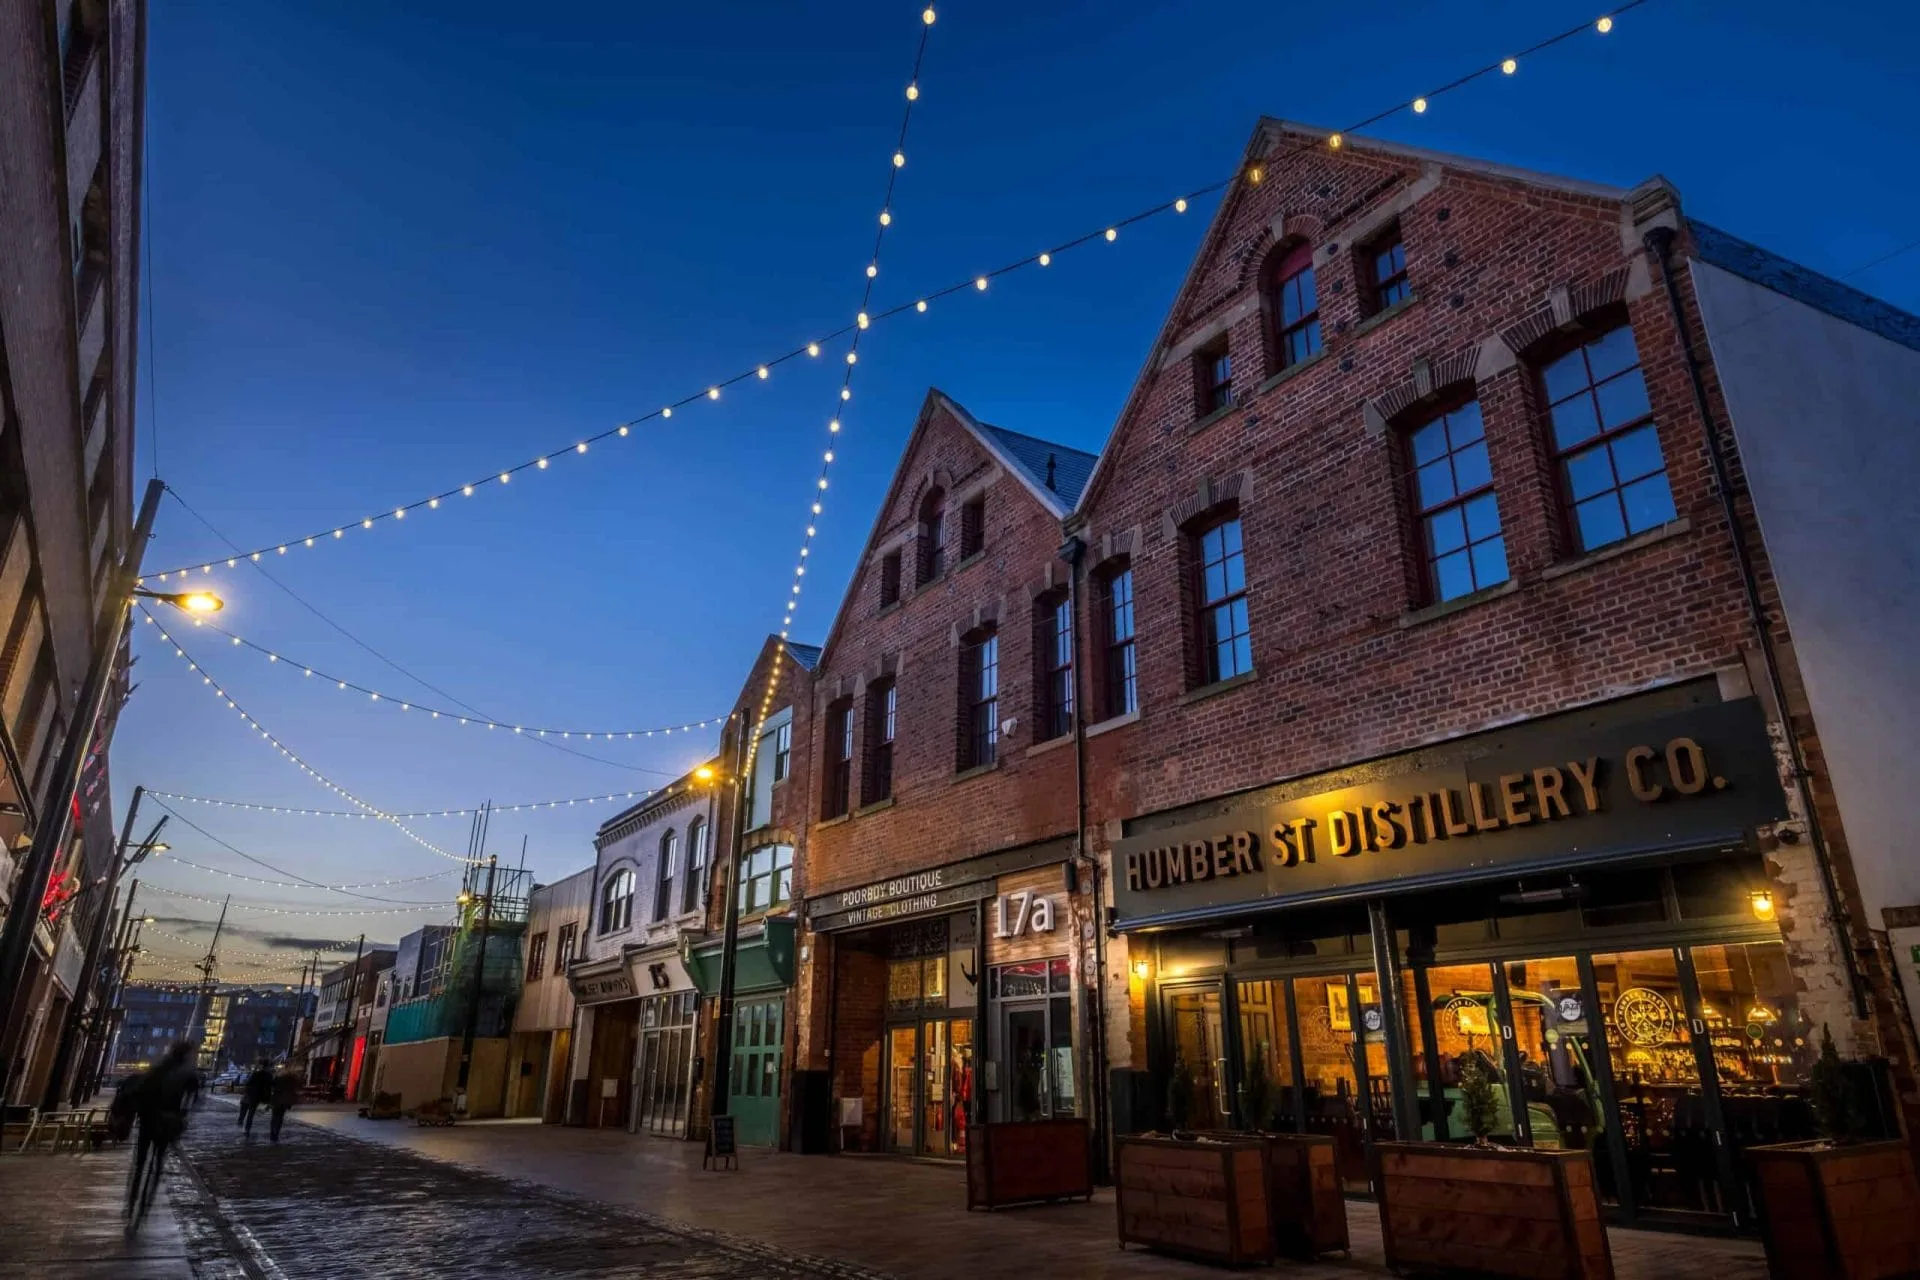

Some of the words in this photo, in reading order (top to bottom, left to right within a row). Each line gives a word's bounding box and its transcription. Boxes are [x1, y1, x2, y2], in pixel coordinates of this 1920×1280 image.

[1124, 830, 1261, 892] HUMBER
[1269, 816, 1317, 868] ST
[1327, 756, 1603, 857] DISTILLERY
[1624, 736, 1730, 804] CO.
[842, 883, 886, 907] POORBOY
[889, 869, 942, 896] BOUTIQUE
[847, 908, 883, 925] VINTAGE
[889, 893, 937, 916] CLOTHING
[992, 890, 1056, 939] 17a
